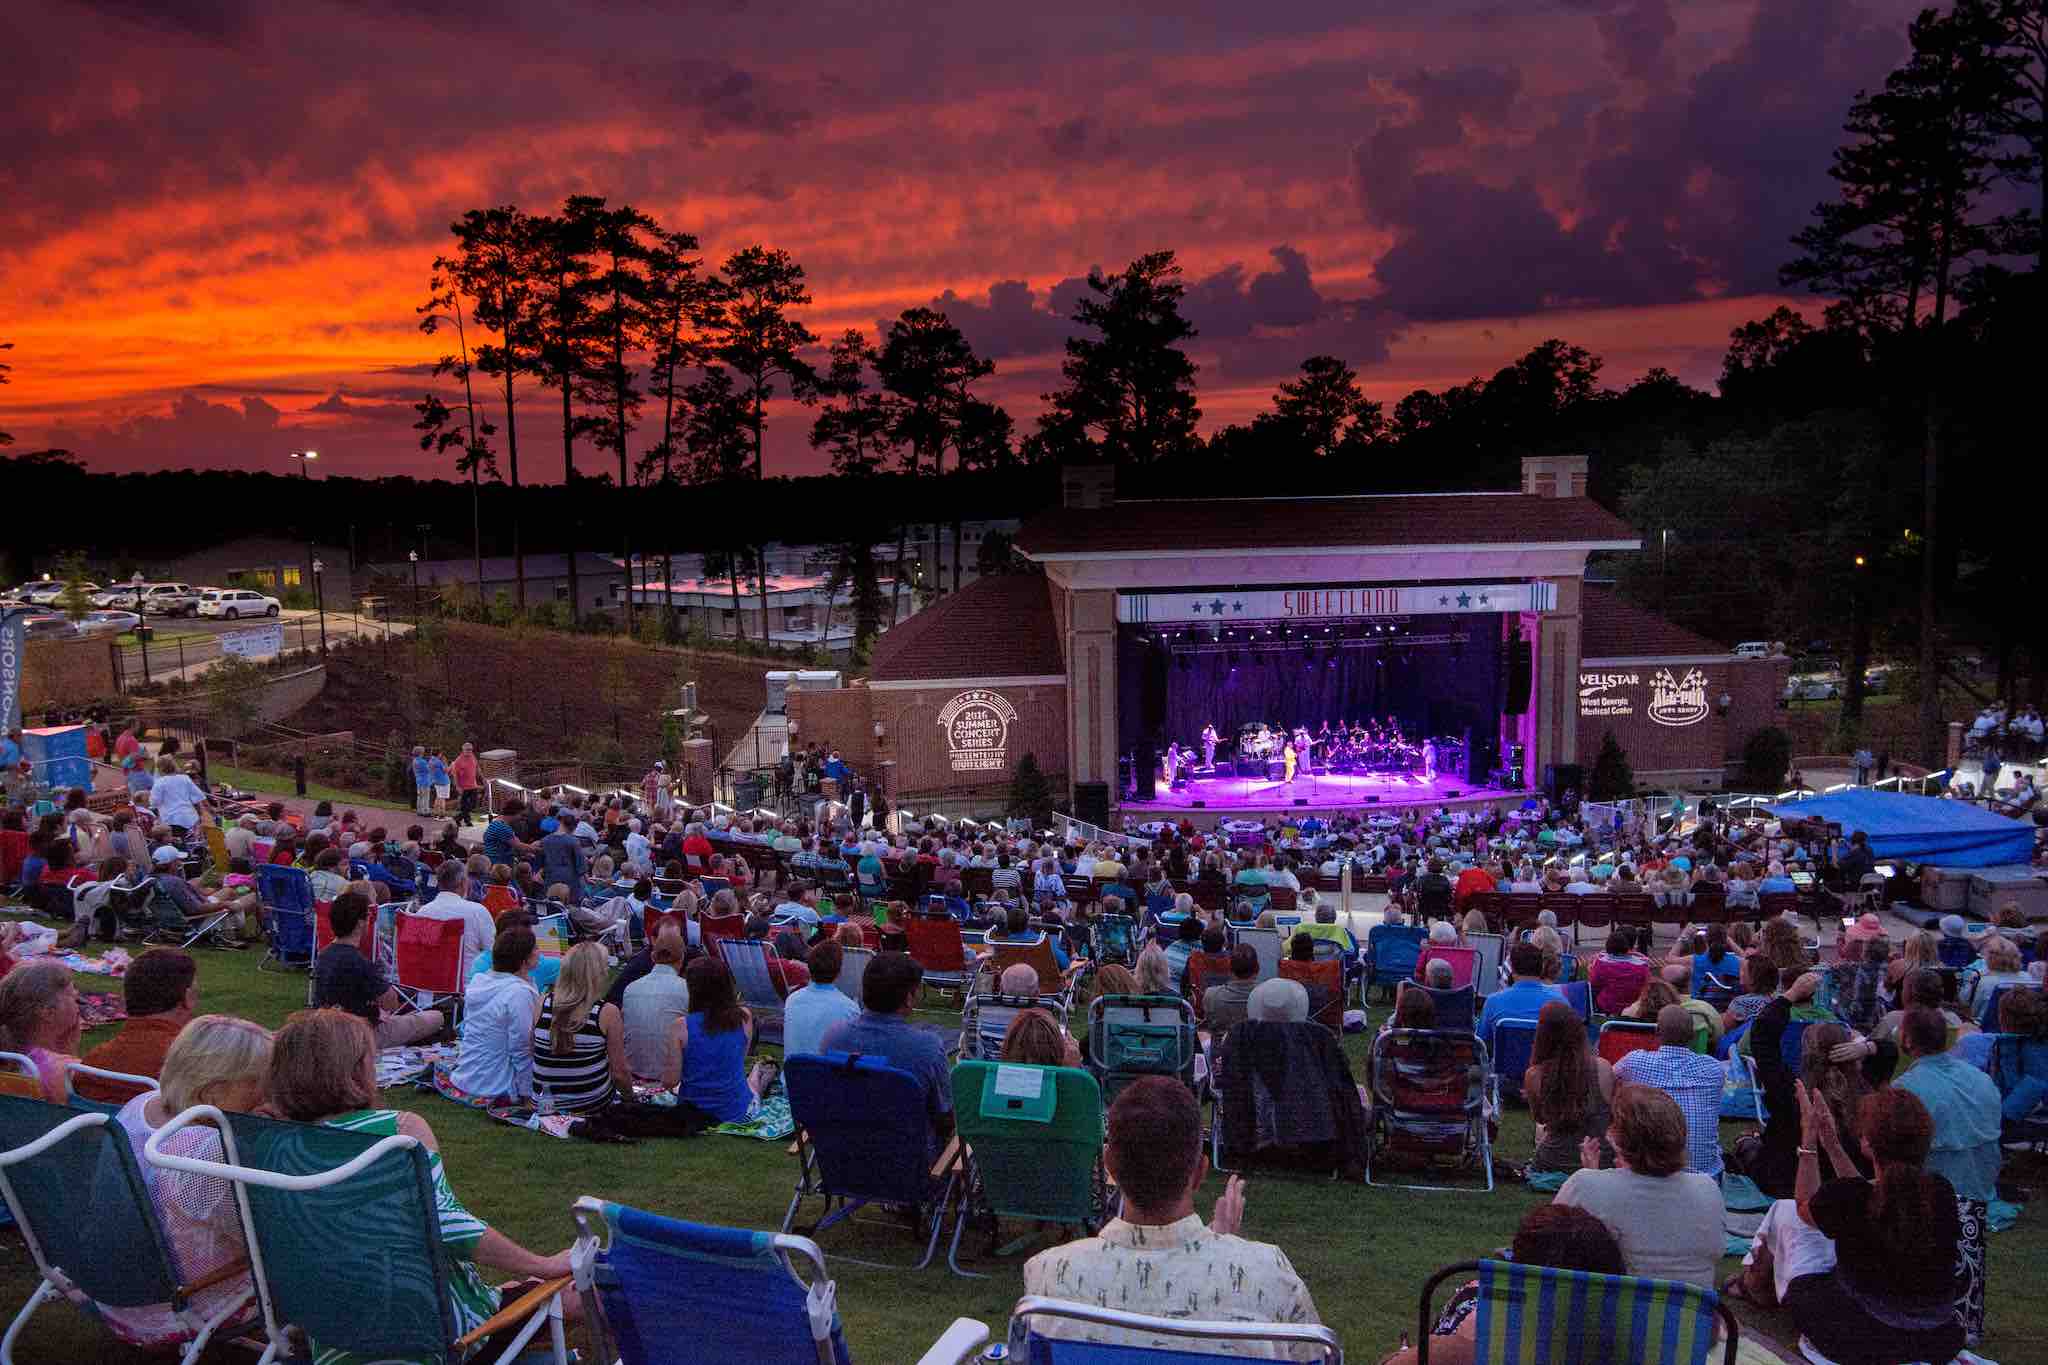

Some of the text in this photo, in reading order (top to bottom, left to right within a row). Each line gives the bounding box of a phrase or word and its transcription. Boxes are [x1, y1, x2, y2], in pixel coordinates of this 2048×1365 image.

[1284, 589, 1398, 616] SWEETLAND
[965, 711, 988, 720] 2016
[956, 720, 998, 730] SUMMER
[954, 728, 1000, 739] CONCERT
[961, 738, 993, 748] SERIES
